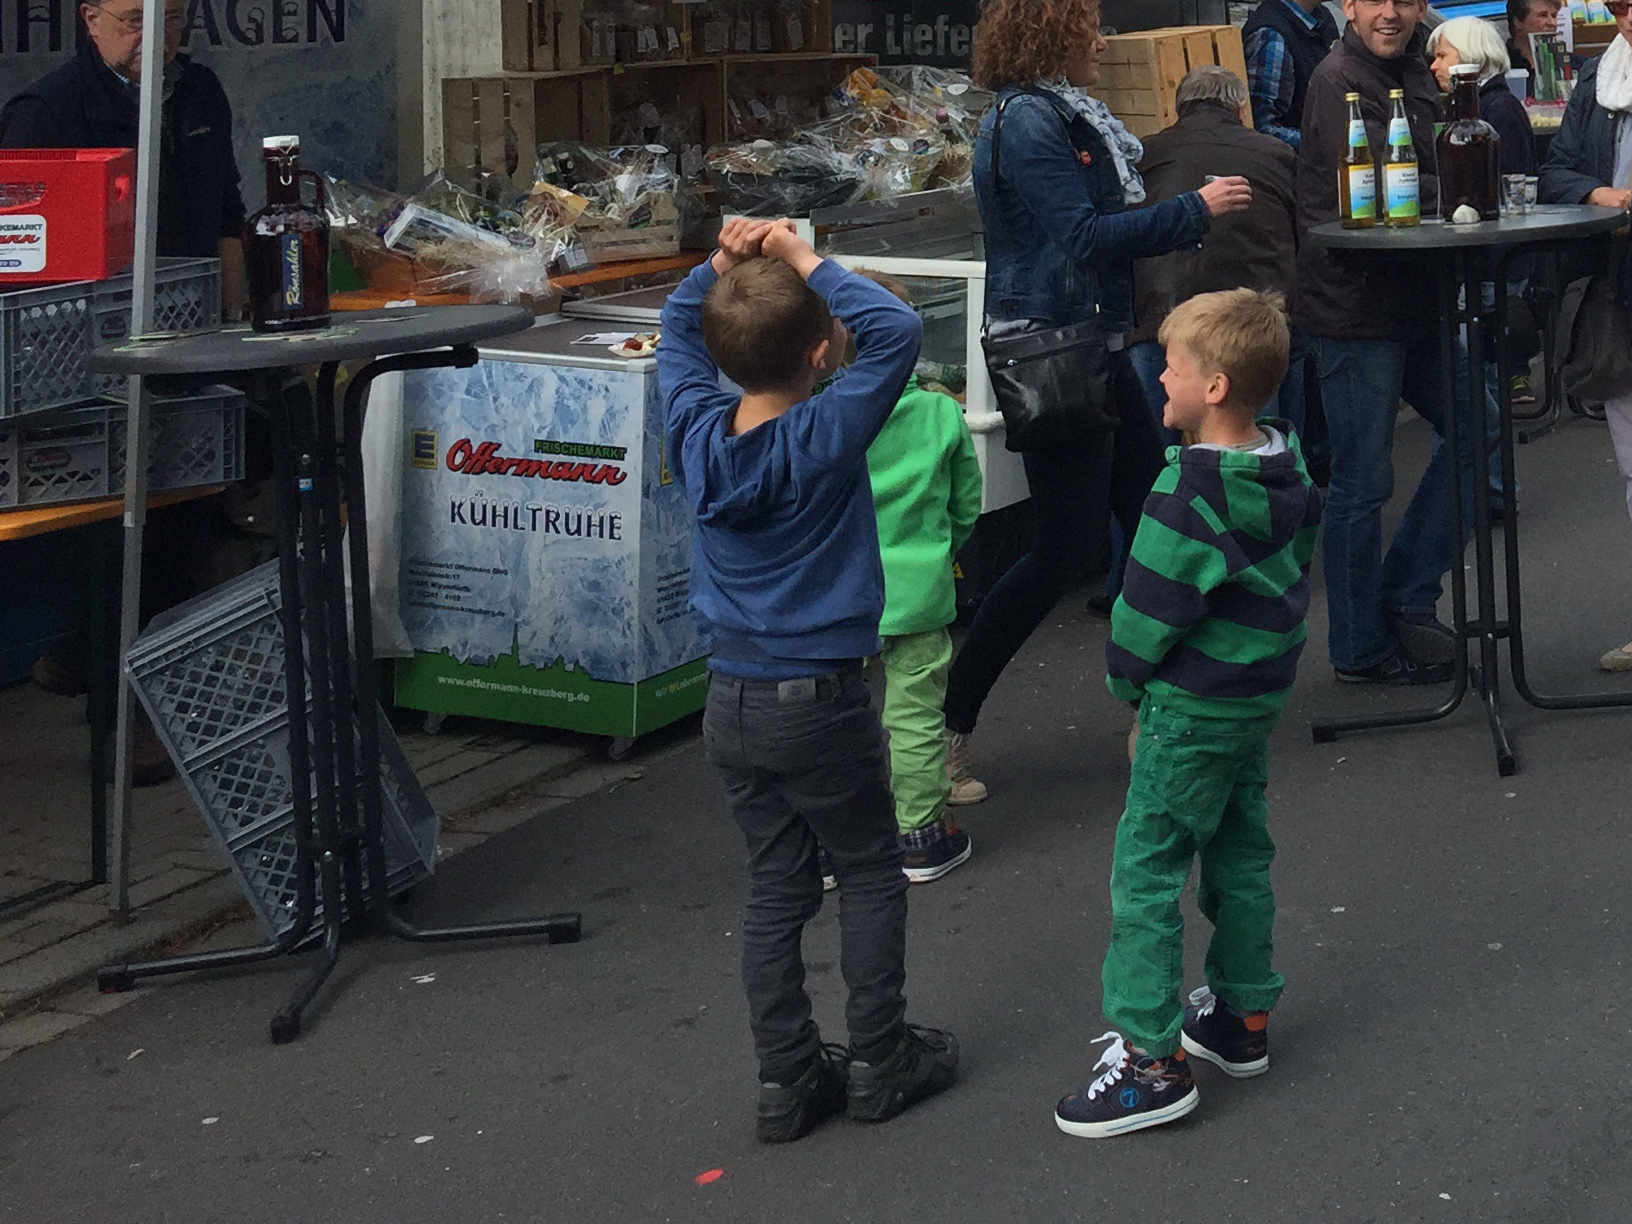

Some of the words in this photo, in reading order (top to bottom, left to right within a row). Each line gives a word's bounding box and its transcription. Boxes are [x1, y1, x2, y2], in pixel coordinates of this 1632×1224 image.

[885, 13, 977, 57] Liefe
[446, 437, 628, 486] Offermann
[535, 440, 627, 460] FRISCHEMARKT
[449, 489, 623, 542] KÜHLTRUHE
